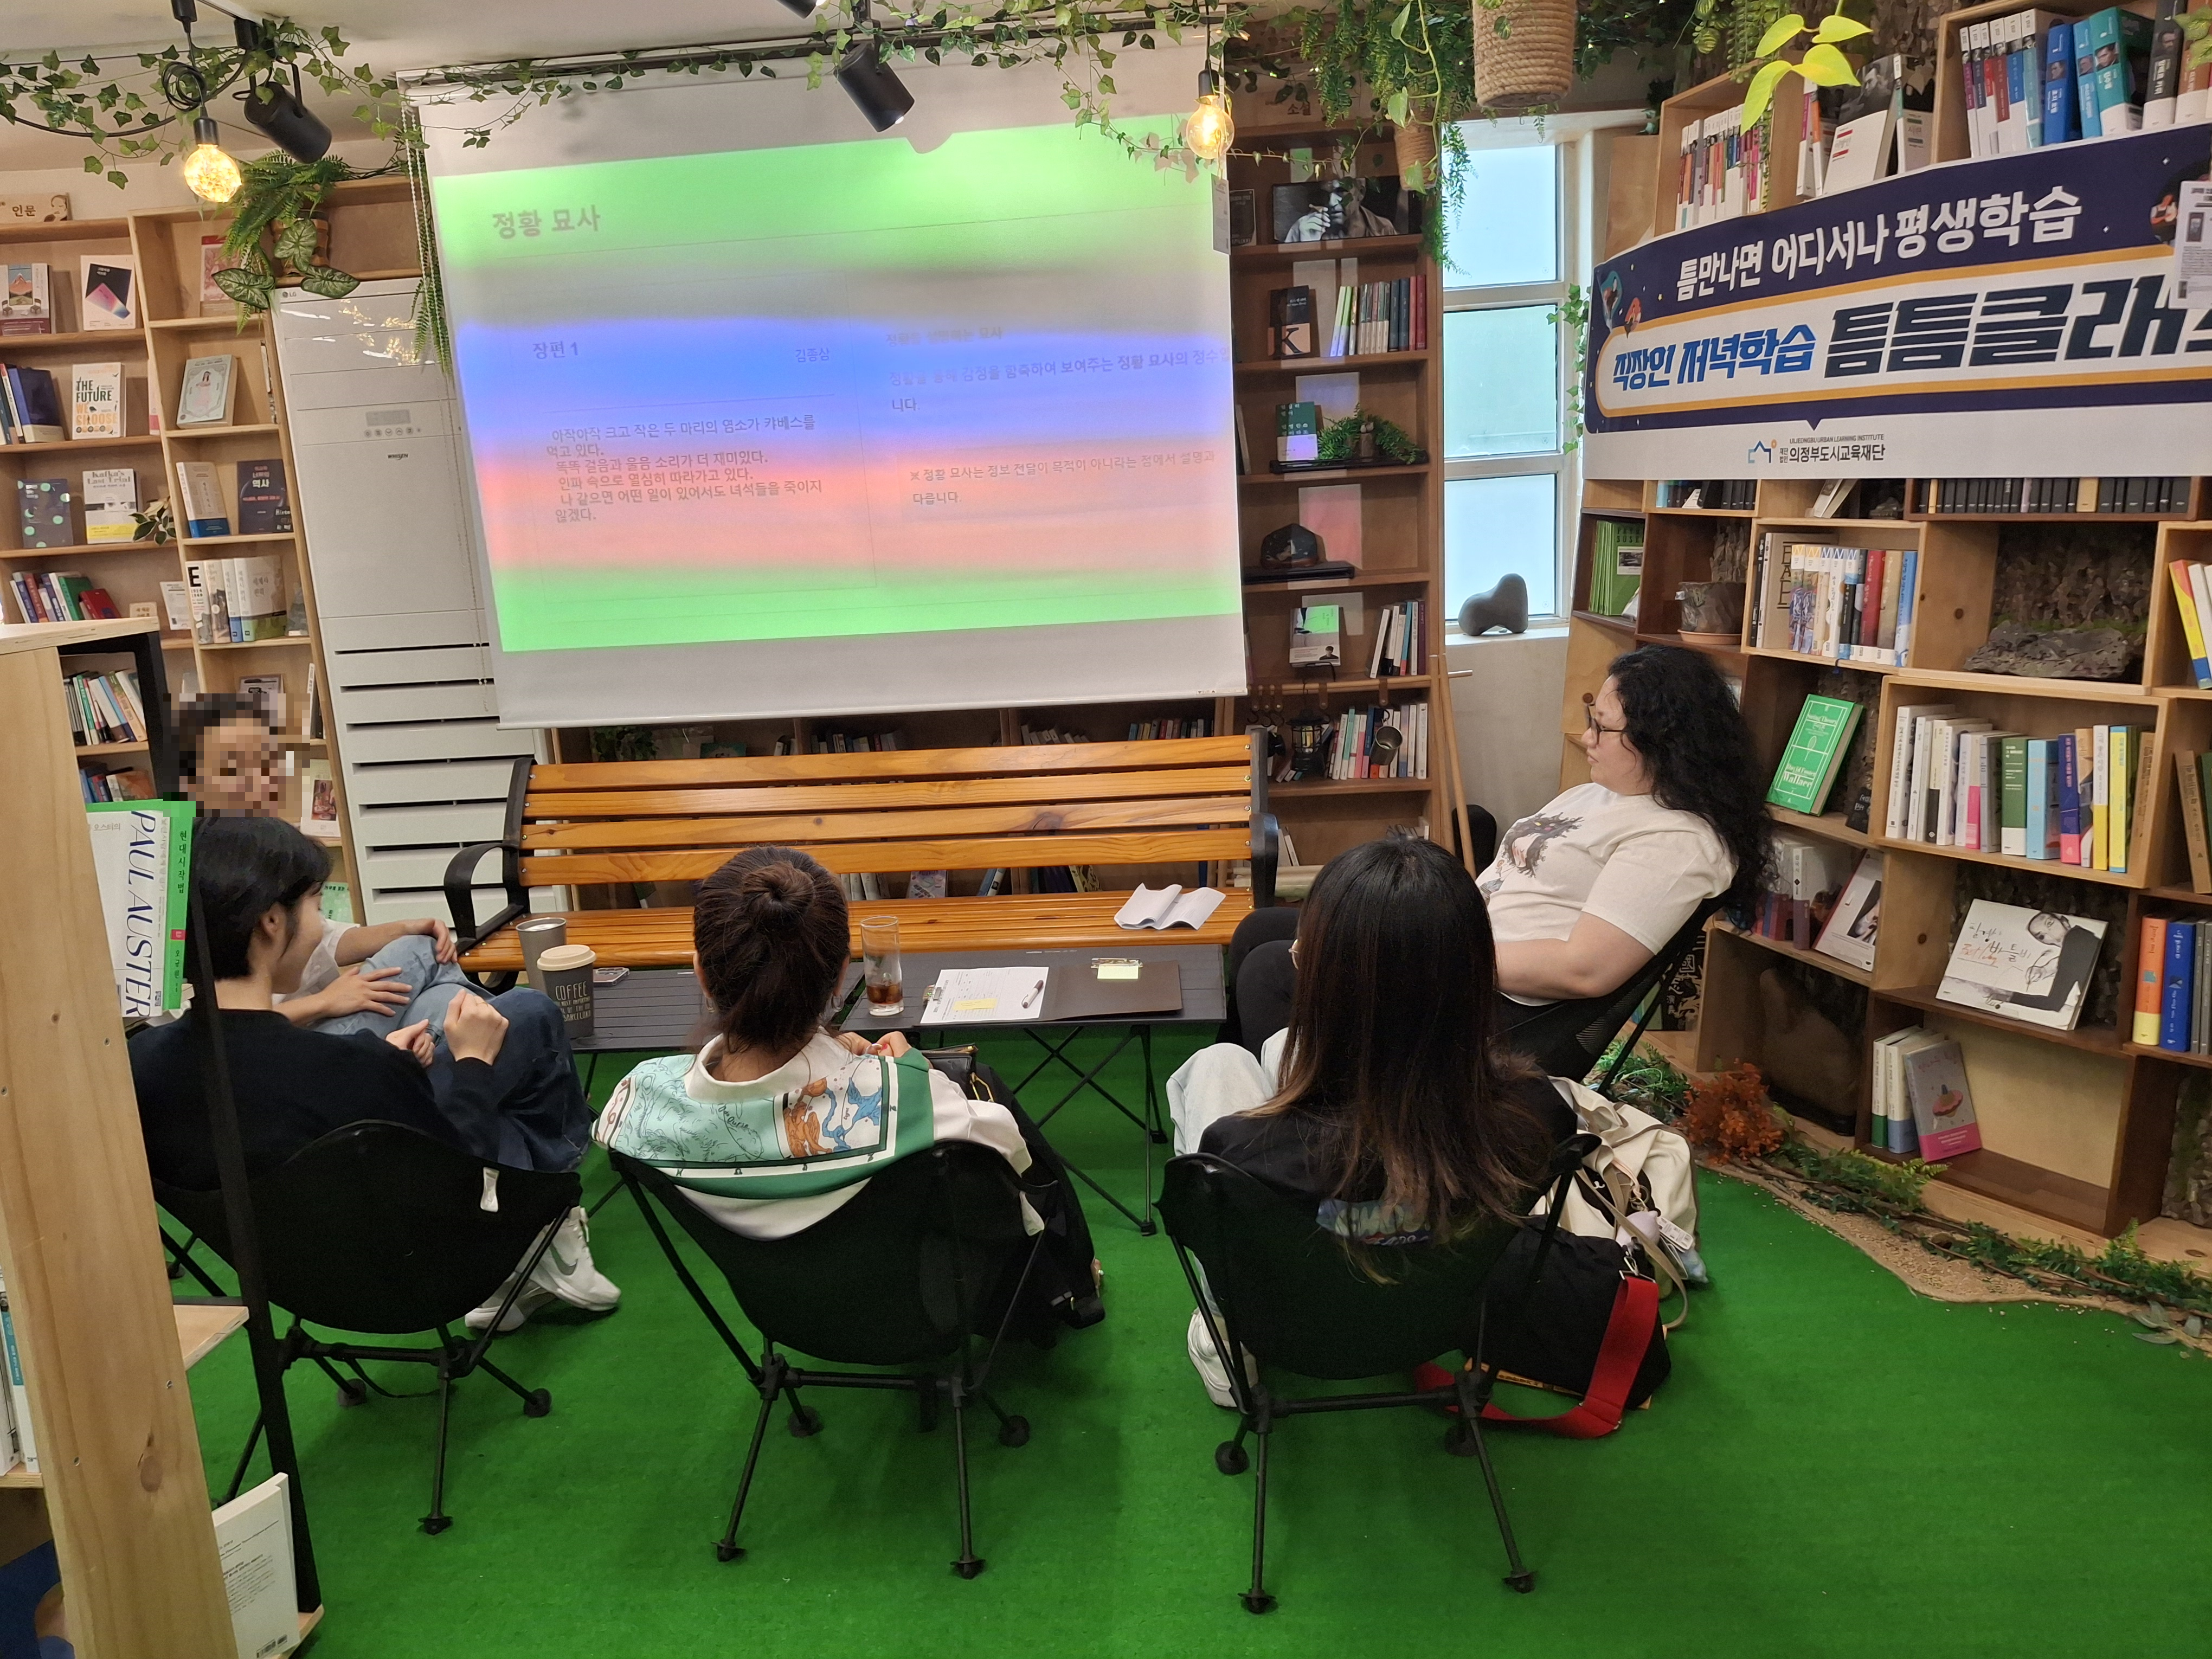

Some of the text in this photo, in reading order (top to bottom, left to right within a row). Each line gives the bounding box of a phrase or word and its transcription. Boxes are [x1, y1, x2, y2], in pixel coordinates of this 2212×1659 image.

[12, 204, 36, 217] 인문
[492, 203, 601, 240] 정황 묘사
[1676, 185, 2083, 303] 틈만나면 어디서나 평생학습
[979, 326, 1003, 340] 묘사
[532, 341, 579, 360] 장편 1
[794, 347, 830, 363] 김종삼
[1612, 345, 1675, 391] 직장인
[1676, 323, 1816, 387] 저녁학습
[1061, 357, 1114, 374] 보여주는
[1117, 353, 1144, 370] 정황
[1147, 351, 1188, 367] 묘사의
[76, 377, 94, 391] THE
[76, 385, 112, 403] FUTURE
[551, 427, 601, 442] 아작아작
[605, 426, 631, 439] 크고
[634, 423, 660, 438] 작은
[664, 422, 676, 436] 두
[680, 420, 717, 435] 마리의
[722, 417, 760, 433] 염소가
[546, 443, 604, 458] 먹고 있다.
[1789, 443, 1886, 463] 의정부도시교육재단
[556, 450, 769, 473] 똑똑 걸음과 울음 소리가 더 재미있다.
[923, 468, 946, 482] 정황
[950, 465, 984, 481] 묘사는
[987, 464, 1011, 478] 정보
[1014, 461, 1048, 476] 전달이
[1052, 459, 1086, 473] 목적이
[1090, 455, 1136, 471] 아니라는
[1140, 452, 1176, 467] 점에서
[1180, 450, 1215, 465] 설명과
[252, 478, 270, 488] 역사
[560, 467, 754, 491] 인파 속으로 열심히 따라가고 있다.
[561, 479, 822, 506] 나 같으면 어떤 일이 있어서도 녀석들을 죽이지
[912, 491, 962, 505] 다릅니다.
[188, 566, 201, 587] E
[177, 829, 187, 894] 현대시작법
[125, 811, 156, 1017] PAUL AUSTER
[555, 981, 588, 1001] COFFEE
